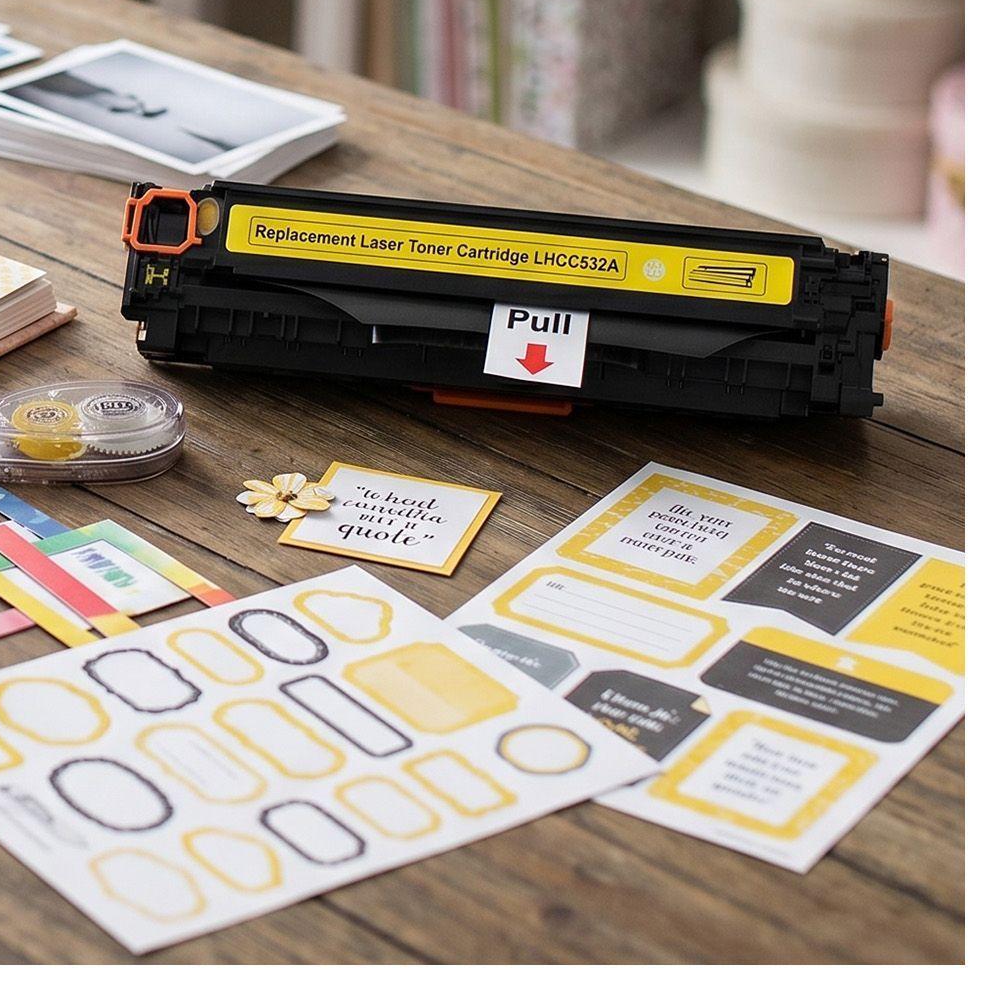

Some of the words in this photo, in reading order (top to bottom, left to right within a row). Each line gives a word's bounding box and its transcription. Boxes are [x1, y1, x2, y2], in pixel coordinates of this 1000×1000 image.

[255, 224, 357, 247] Replacement
[361, 235, 404, 251] Laser
[409, 239, 453, 256] Toner
[457, 244, 529, 266] Cartridge
[533, 251, 620, 273] LHCC532A
[507, 308, 572, 335] Pull
